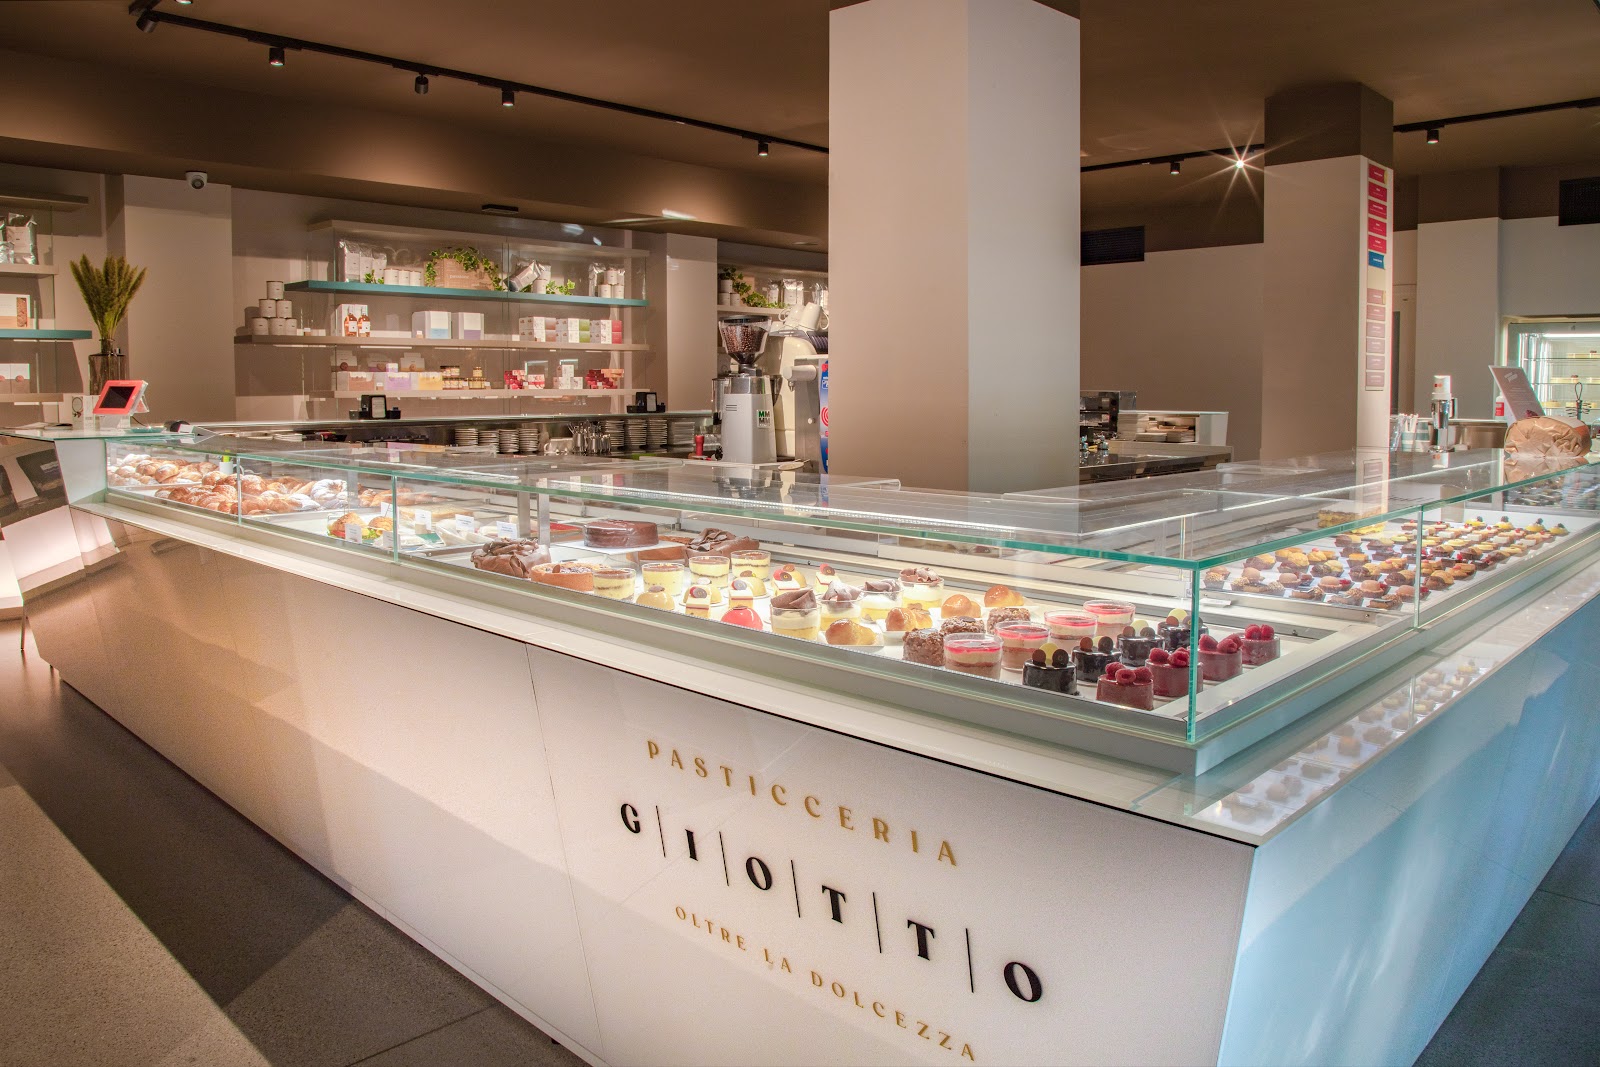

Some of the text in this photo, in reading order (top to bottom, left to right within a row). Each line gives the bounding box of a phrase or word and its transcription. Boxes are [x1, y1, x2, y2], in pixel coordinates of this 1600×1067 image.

[647, 740, 958, 867] PASTICCERIA
[675, 906, 976, 1062] OLTRE LA DOLCEZZA
